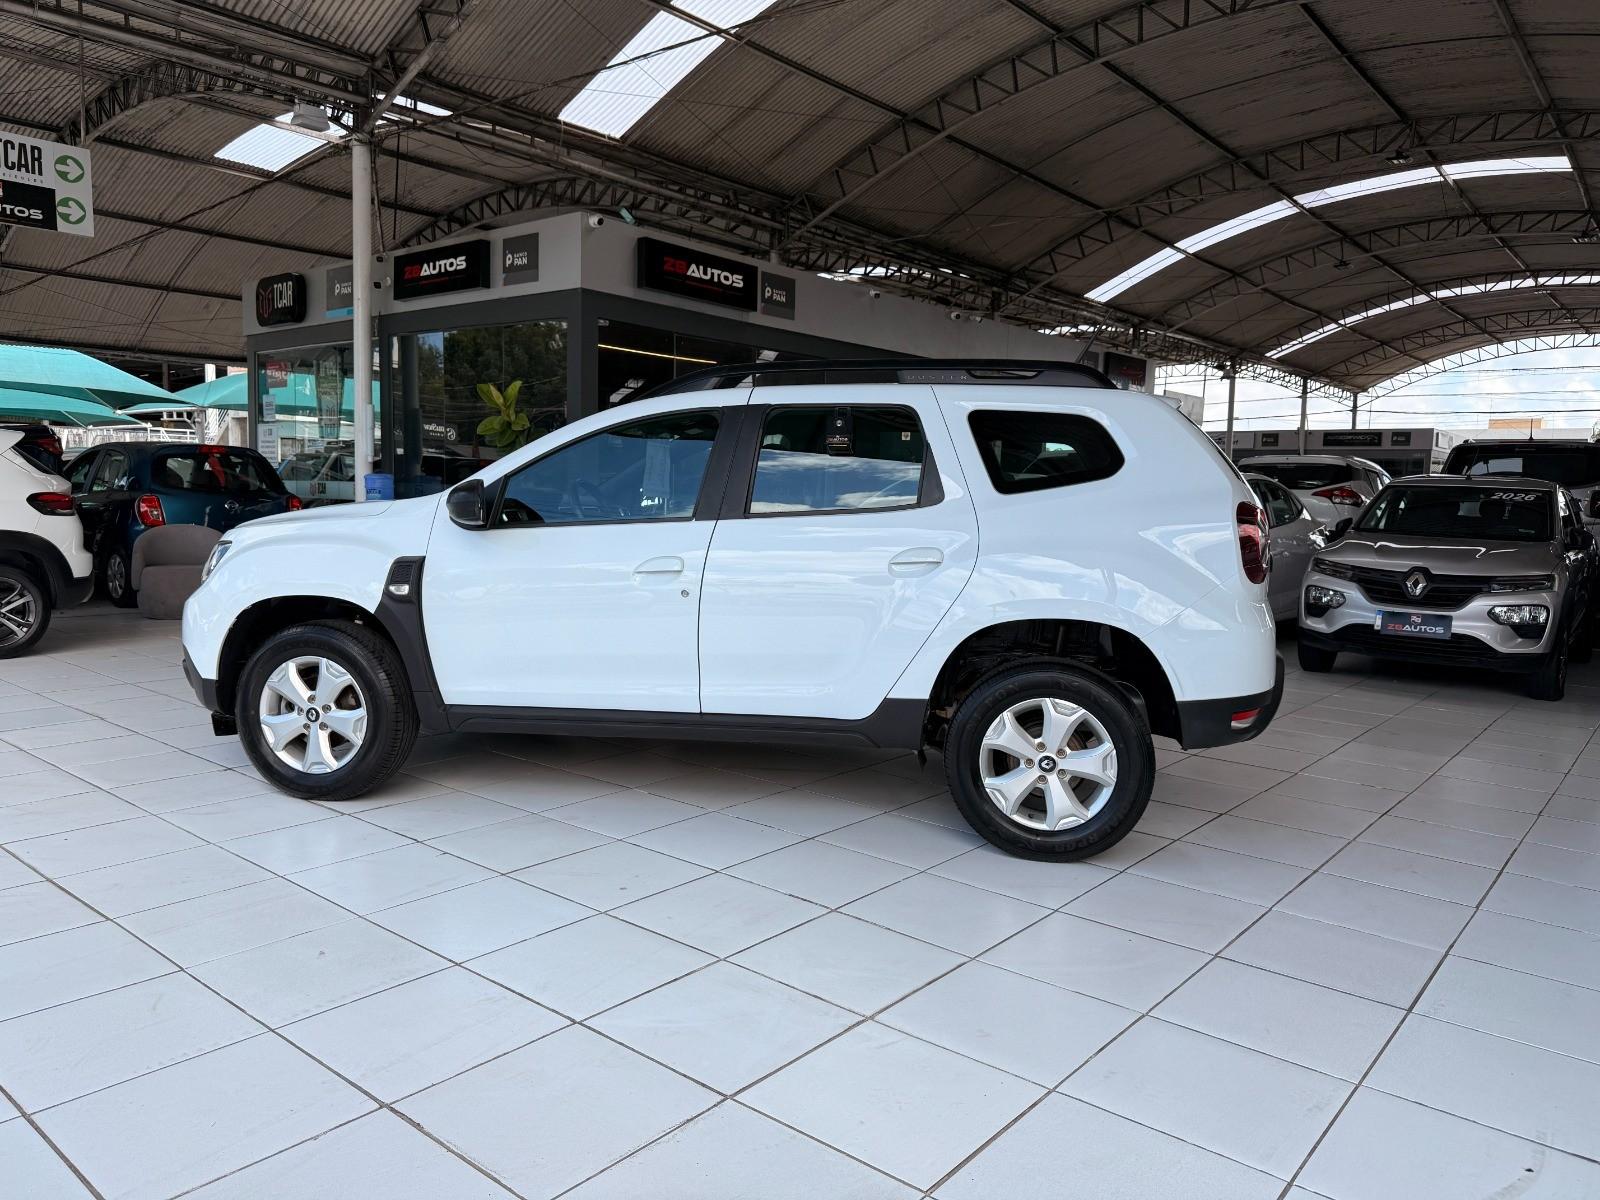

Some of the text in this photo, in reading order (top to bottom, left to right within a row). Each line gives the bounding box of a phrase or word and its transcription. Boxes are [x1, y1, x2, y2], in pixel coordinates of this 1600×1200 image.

[0, 138, 43, 176] CAR
[0, 203, 43, 220] TOS
[513, 256, 528, 267] PAN
[772, 293, 786, 303] PAN
[1490, 492, 1537, 501] 2026
